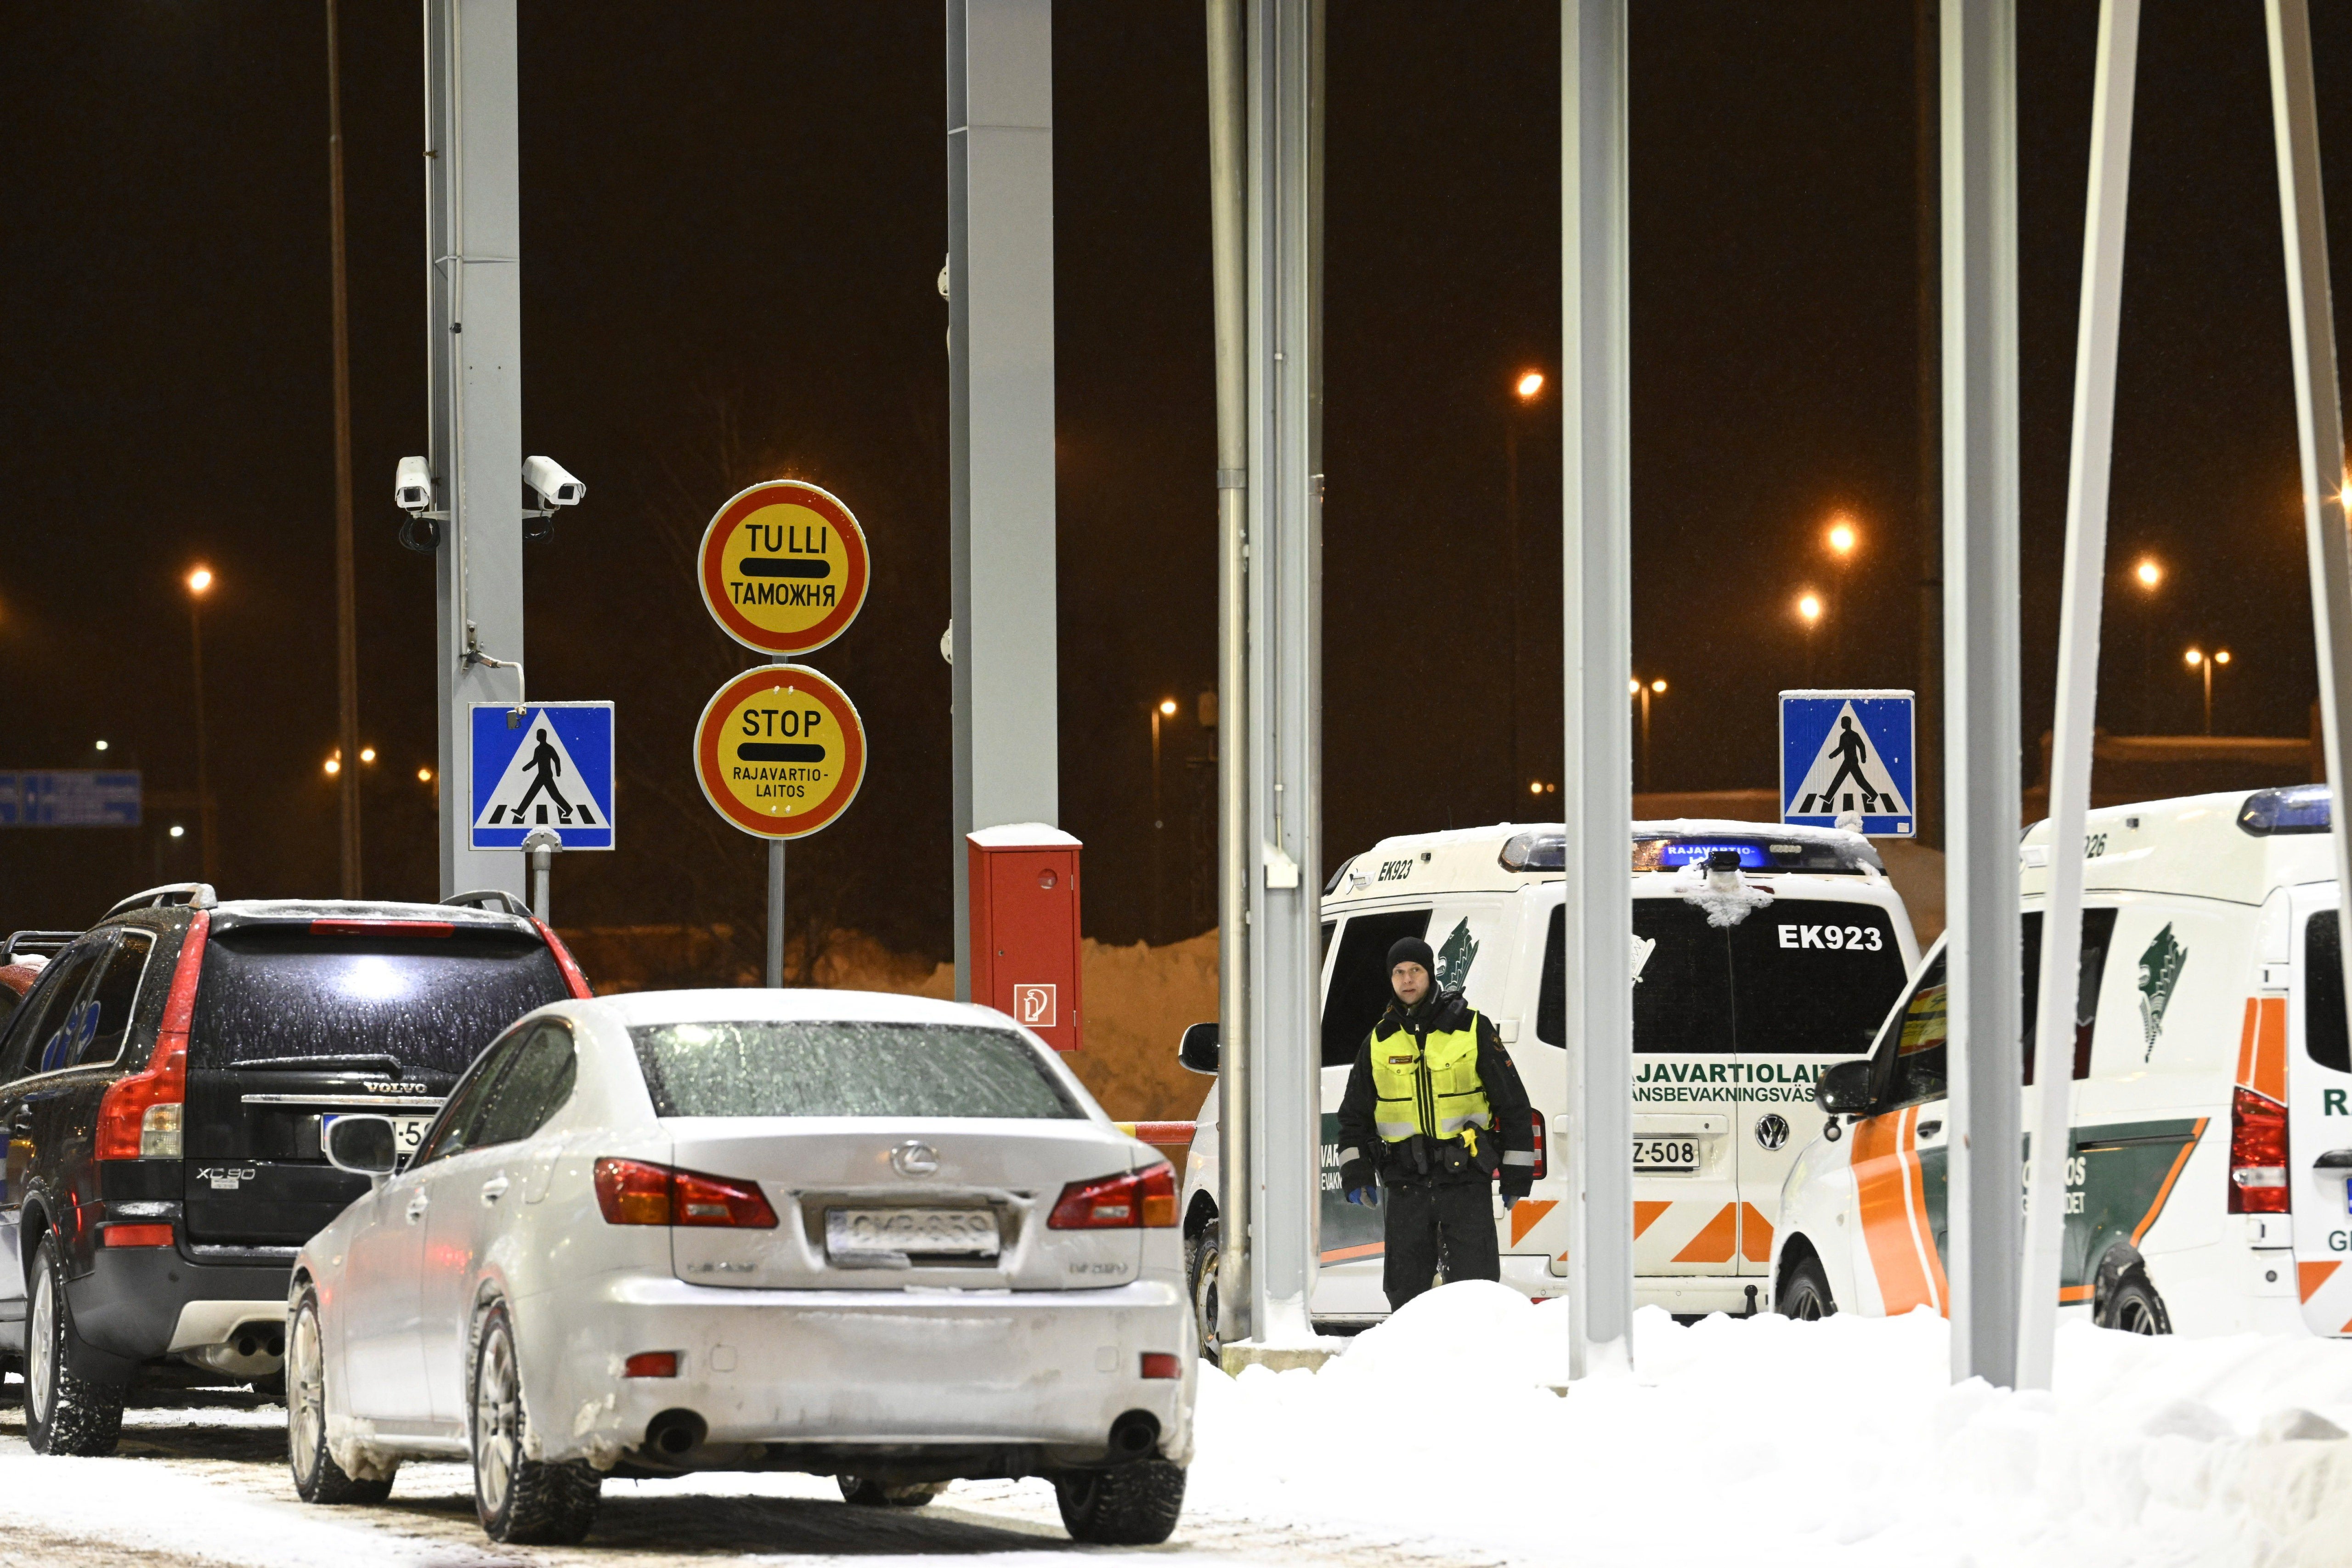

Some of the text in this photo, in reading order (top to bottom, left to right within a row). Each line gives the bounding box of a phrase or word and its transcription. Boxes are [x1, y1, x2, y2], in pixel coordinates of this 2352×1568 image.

[745, 524, 827, 554] TULLI
[730, 582, 836, 607] ТАМОЖНЯ
[742, 709, 821, 737] STOP
[733, 767, 829, 781] RAJAVARTIO-
[756, 784, 805, 798] LAITOS
[1378, 859, 1413, 882] EK923
[1777, 924, 1883, 951] EK923
[1632, 1064, 1832, 1083] JAVARTIOLAI
[363, 1081, 428, 1093] VOLVO
[2324, 1089, 2352, 1116] R
